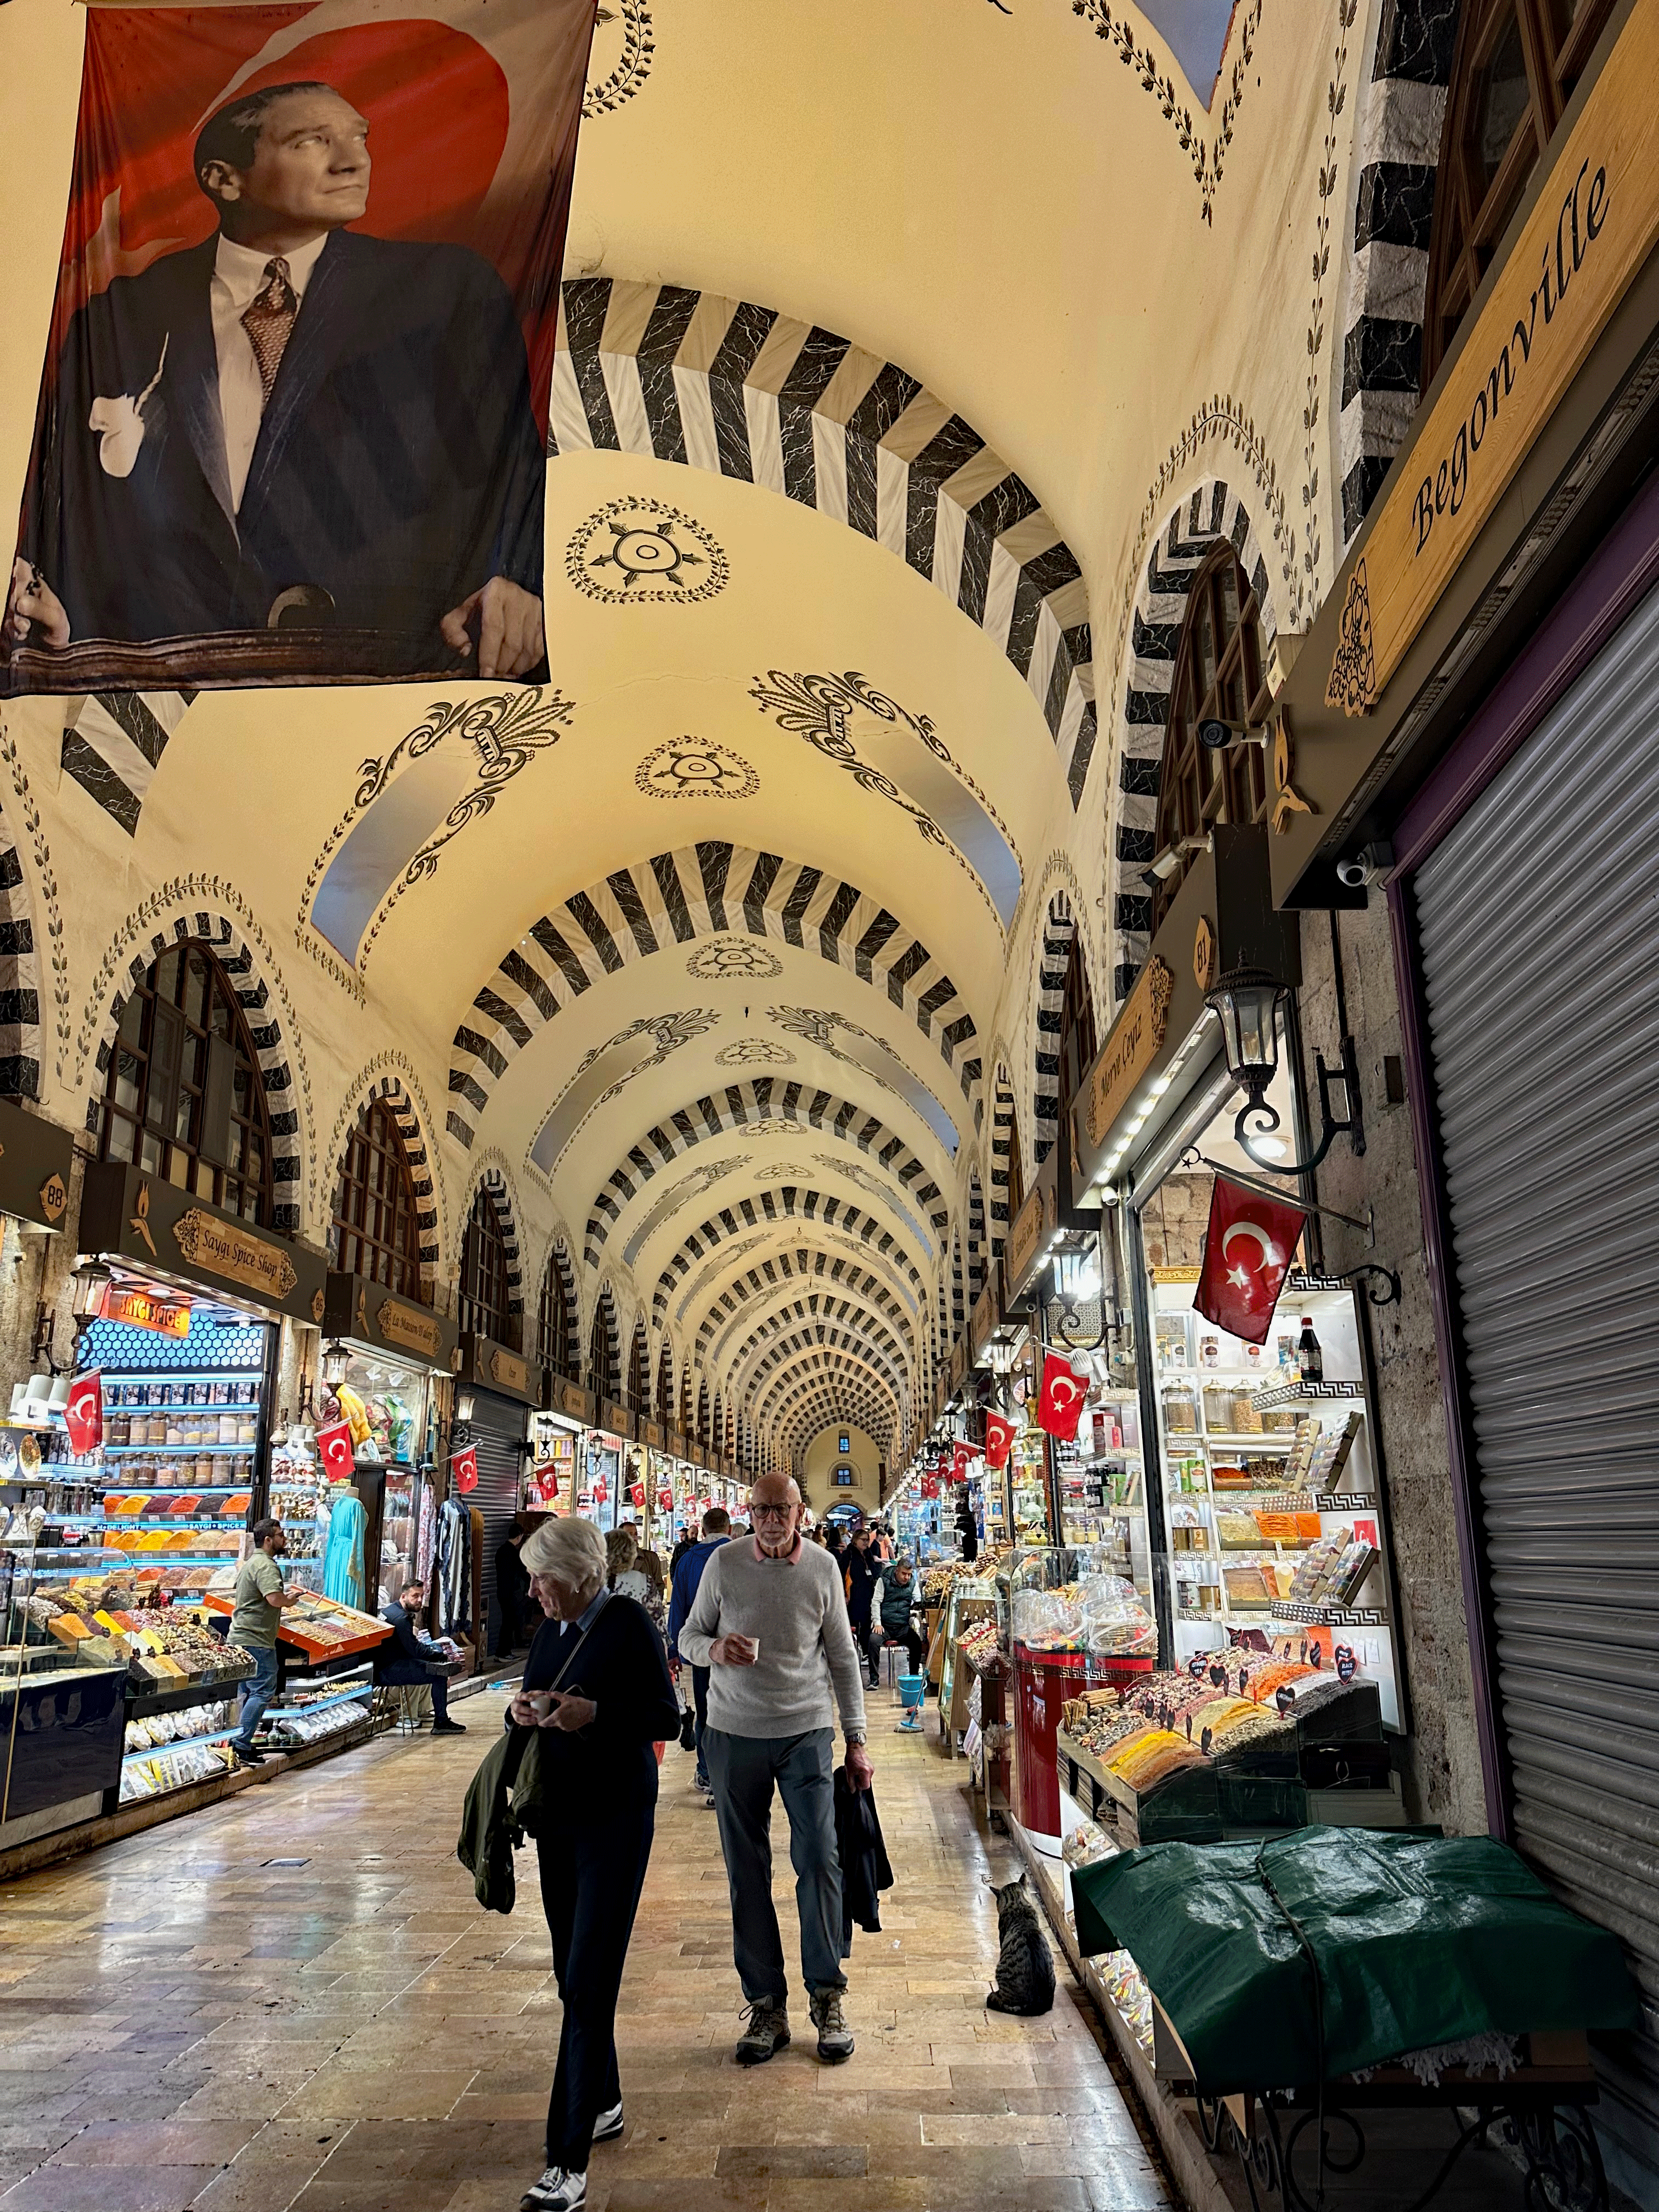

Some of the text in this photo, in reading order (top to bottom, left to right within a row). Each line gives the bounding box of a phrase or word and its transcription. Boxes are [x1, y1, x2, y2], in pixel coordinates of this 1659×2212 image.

[1411, 156, 1611, 557] Begonville
[1197, 933, 1207, 974] 81
[1100, 1053, 1121, 1105] Merve
[47, 1184, 63, 1208] 88
[202, 1229, 278, 1282] Saygı Spice Shop
[120, 1296, 182, 1329] SAYGI SPICE
[315, 1297, 323, 1312] 86
